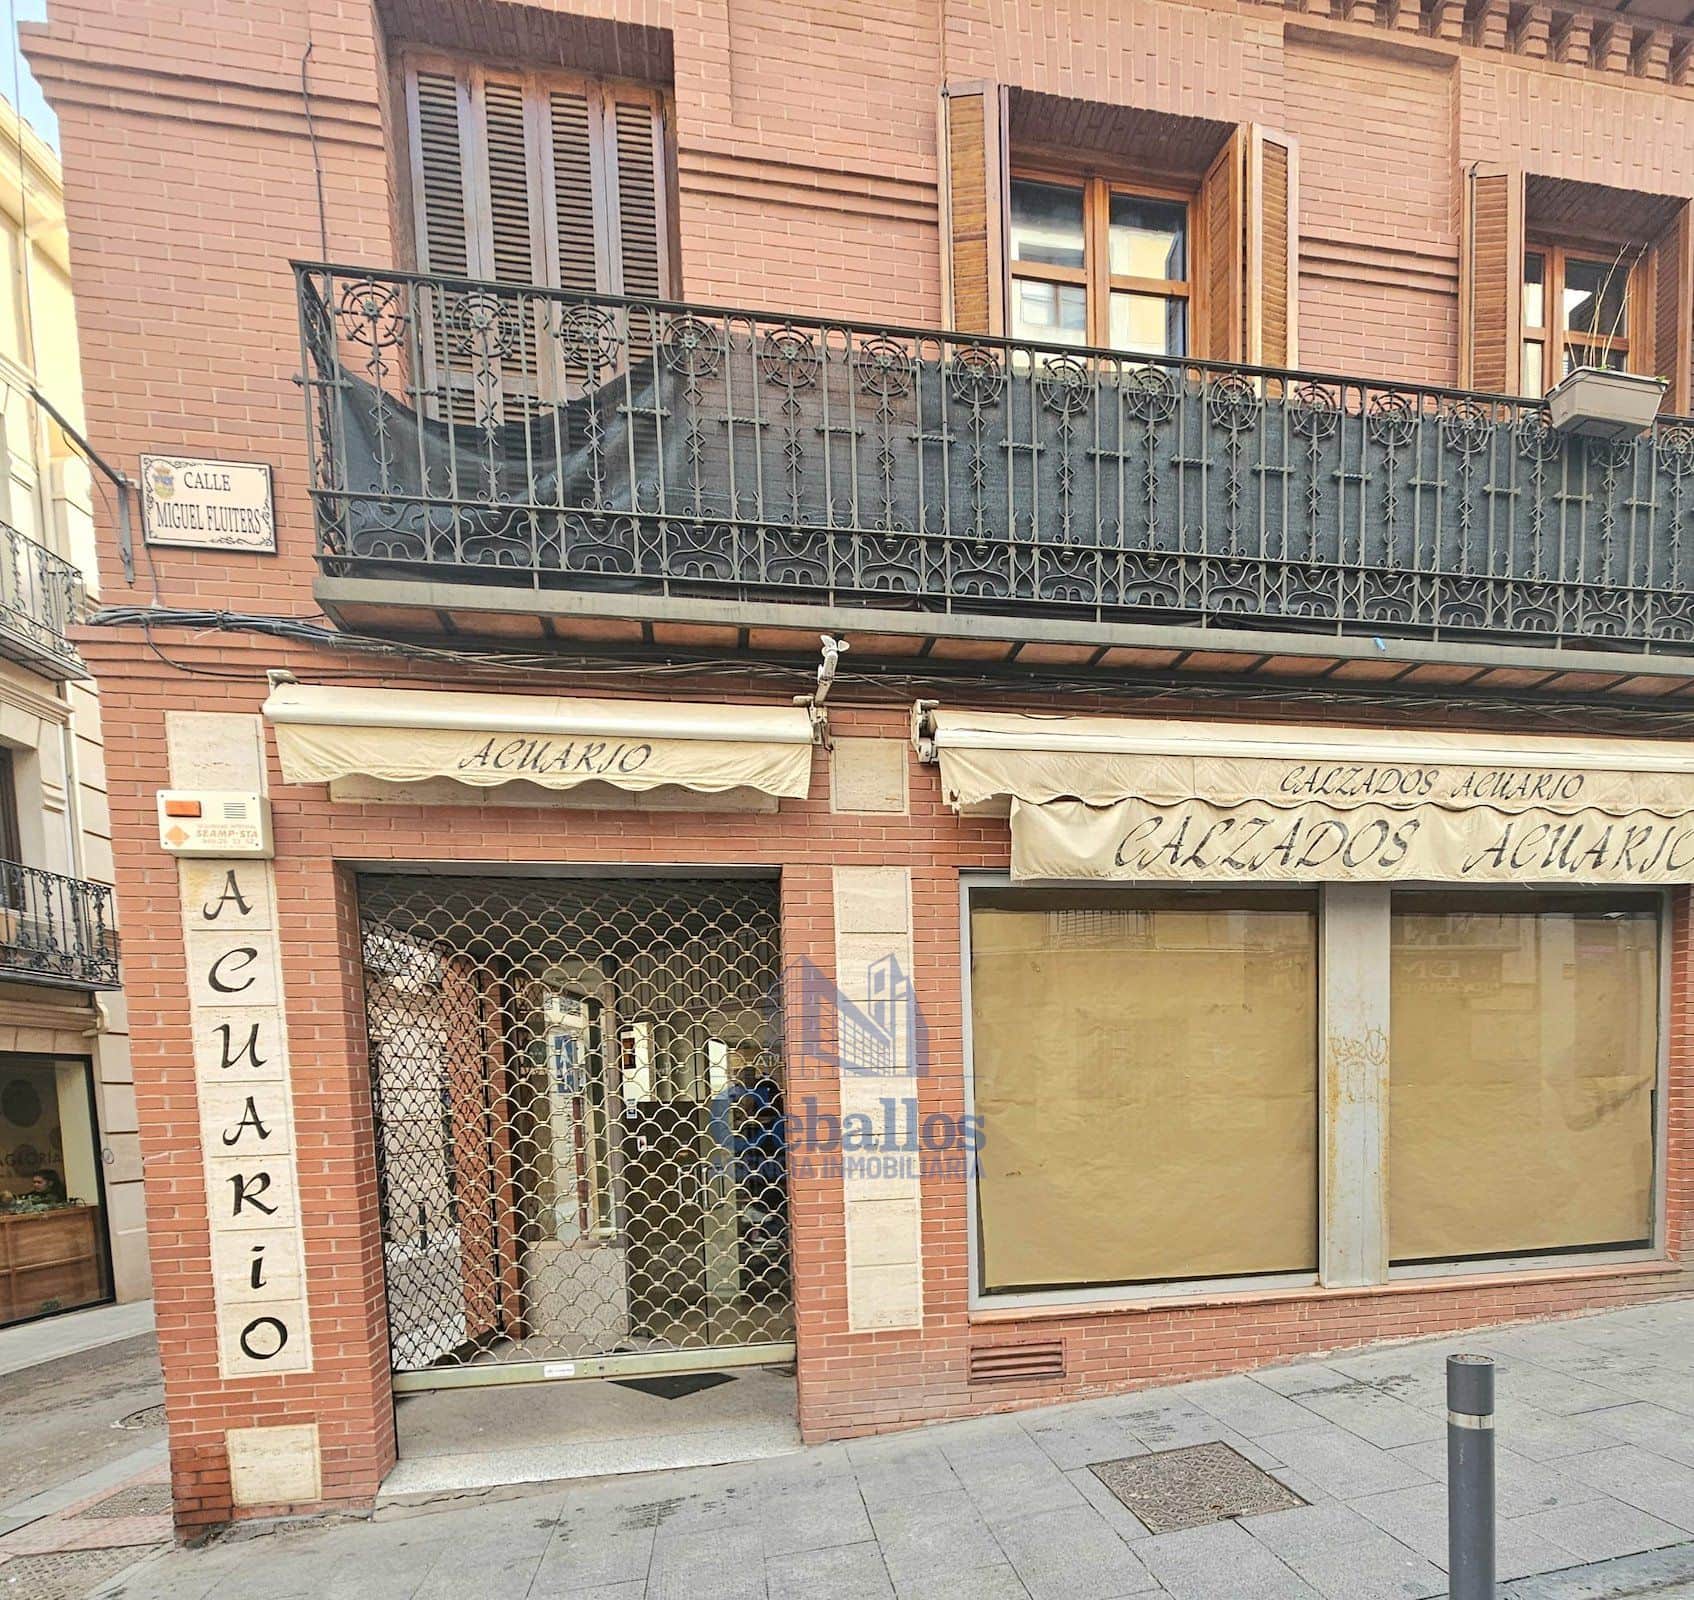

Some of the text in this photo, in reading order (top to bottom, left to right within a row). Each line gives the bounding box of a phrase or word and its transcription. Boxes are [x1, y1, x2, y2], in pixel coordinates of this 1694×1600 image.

[183, 471, 232, 492] CALLE
[155, 501, 262, 535] MIGUEL FLUITERS
[457, 737, 653, 774] ACUARIO
[1279, 765, 1585, 800] CALZADOS ACUARIO
[1114, 815, 1420, 870] CALZADOS
